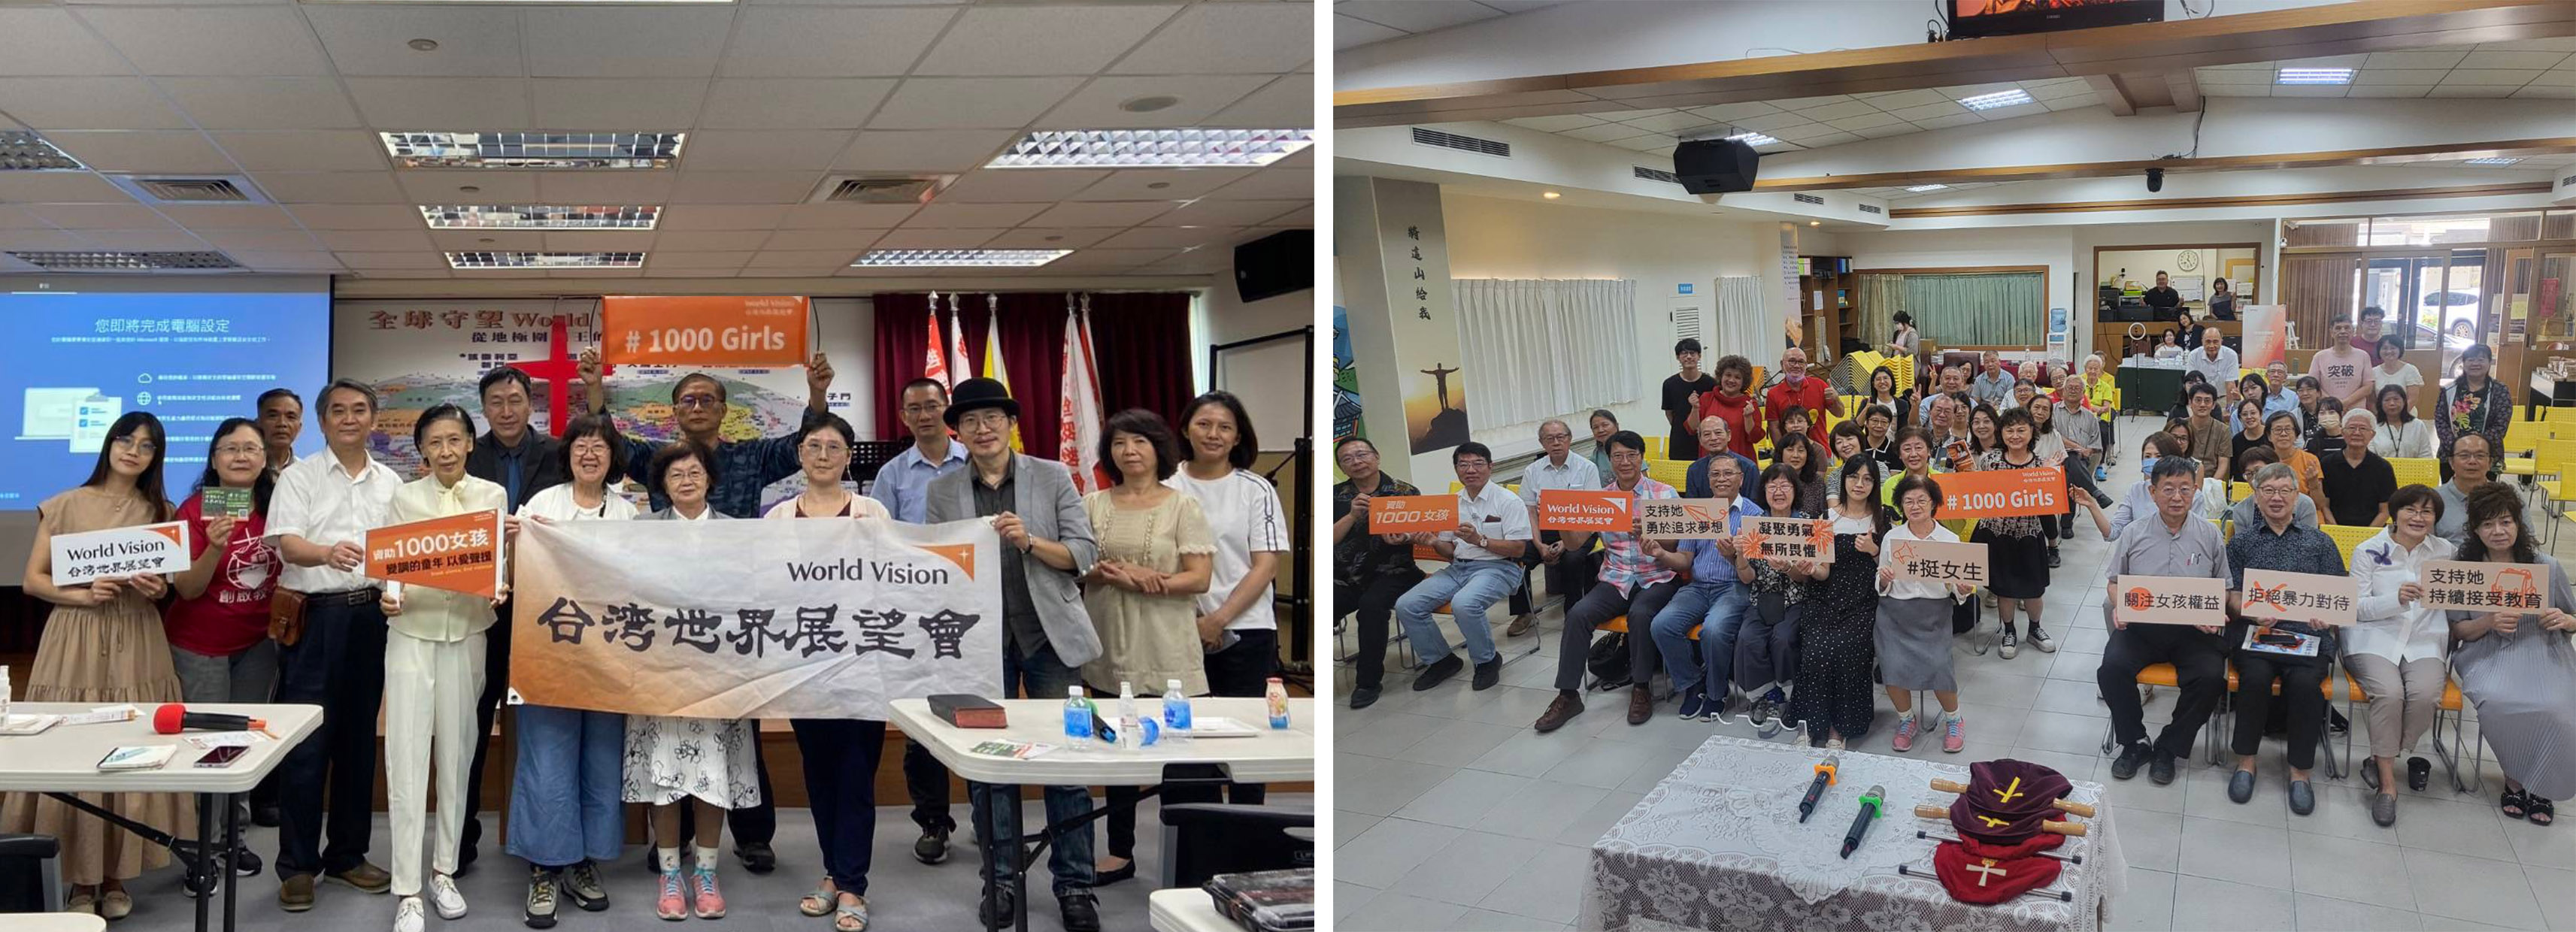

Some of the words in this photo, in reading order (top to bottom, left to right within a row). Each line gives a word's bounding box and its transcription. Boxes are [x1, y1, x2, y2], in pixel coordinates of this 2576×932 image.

[1408, 225, 1432, 320] 將這山給我
[95, 319, 230, 333] 您即將完成電腦設定
[369, 310, 504, 330] 全球守望
[512, 313, 589, 328] Wold
[625, 329, 641, 353] #
[648, 327, 714, 353] 1000
[721, 325, 785, 351] Girls
[2328, 364, 2354, 377] 突破
[1386, 500, 1406, 510] 資助
[1547, 504, 1580, 515] World
[1582, 504, 1614, 515] Vision
[1947, 495, 1958, 511] #
[1962, 492, 2006, 511] 1000
[2011, 489, 2054, 508] Girls
[1645, 504, 1683, 518] 支持她
[1646, 520, 1724, 534] 勇於追求夢想
[1759, 521, 1814, 537] 凝聚勇氣
[68, 543, 114, 561] World
[118, 539, 165, 555] Vision
[1760, 541, 1816, 558] 無所畏懼
[786, 558, 863, 584] World
[870, 560, 949, 585] Vision
[1907, 558, 1984, 582] #挺女生
[2429, 569, 2484, 585] 支持她
[2124, 590, 2220, 612] 關注女孩權益
[2247, 588, 2350, 613] 拒絕暴力對待
[2429, 589, 2542, 609] 持續接受教育
